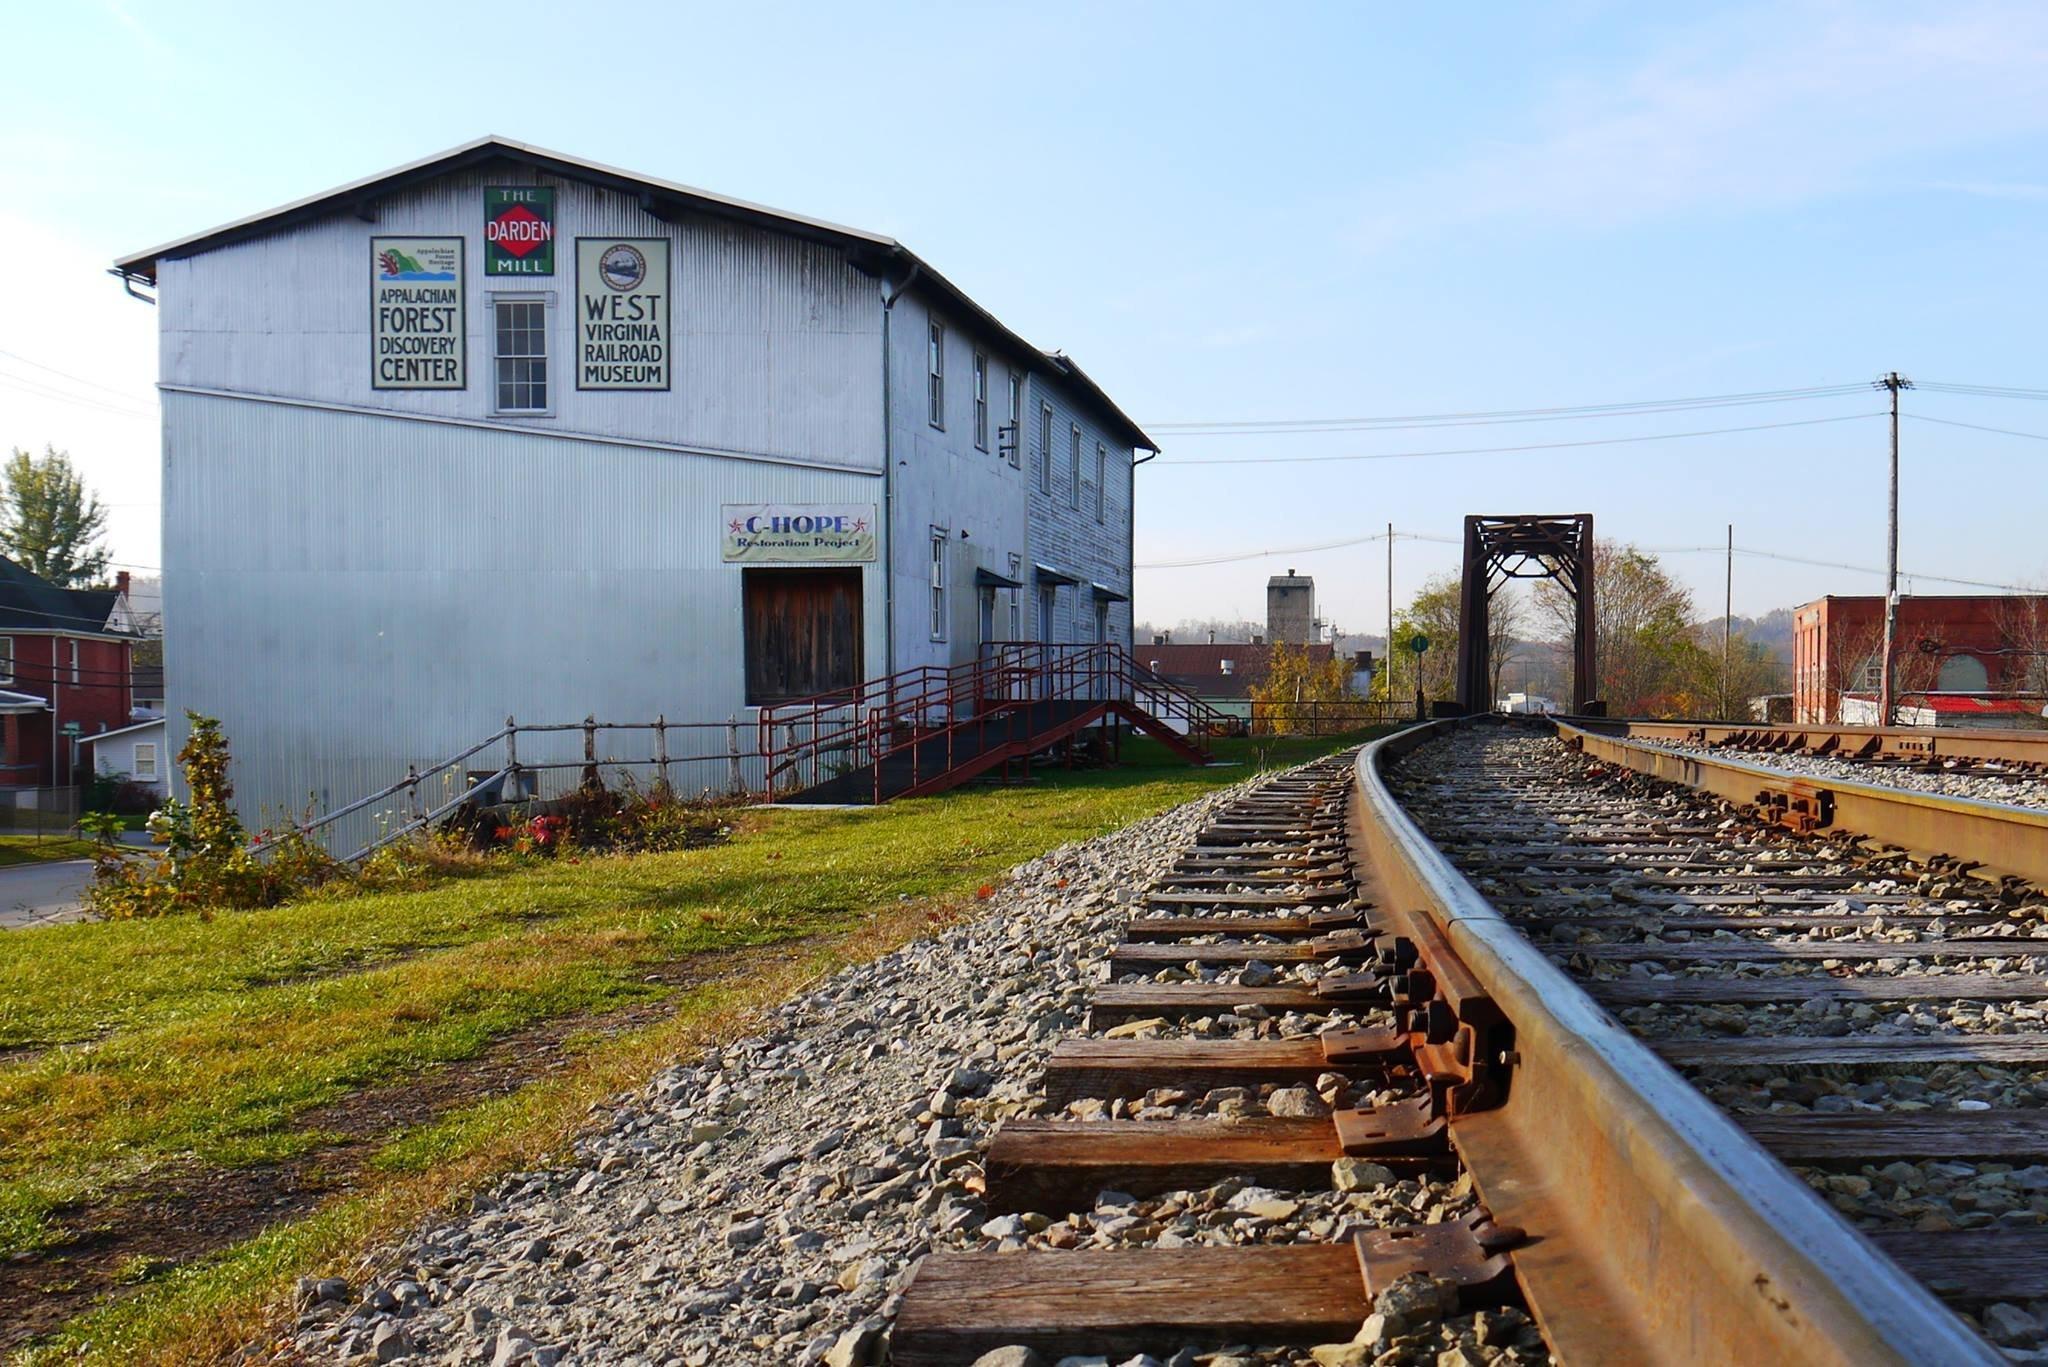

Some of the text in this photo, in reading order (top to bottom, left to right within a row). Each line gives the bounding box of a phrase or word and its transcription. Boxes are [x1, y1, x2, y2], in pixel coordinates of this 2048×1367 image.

[500, 190, 536, 202] THE
[488, 221, 551, 241] DARDEN
[497, 260, 544, 272] MILL
[380, 288, 456, 304] APPALACHIAN
[585, 294, 661, 321] WEST
[380, 307, 456, 333] FOREST
[585, 324, 661, 341] VIRGINIA
[380, 336, 456, 354] DISCOVERY
[585, 344, 662, 362] RAILROAD
[380, 357, 457, 381] CENTER
[585, 365, 661, 383] MUSEUM
[746, 515, 849, 534] C-HOPE
[737, 537, 860, 549] Restoration Project
